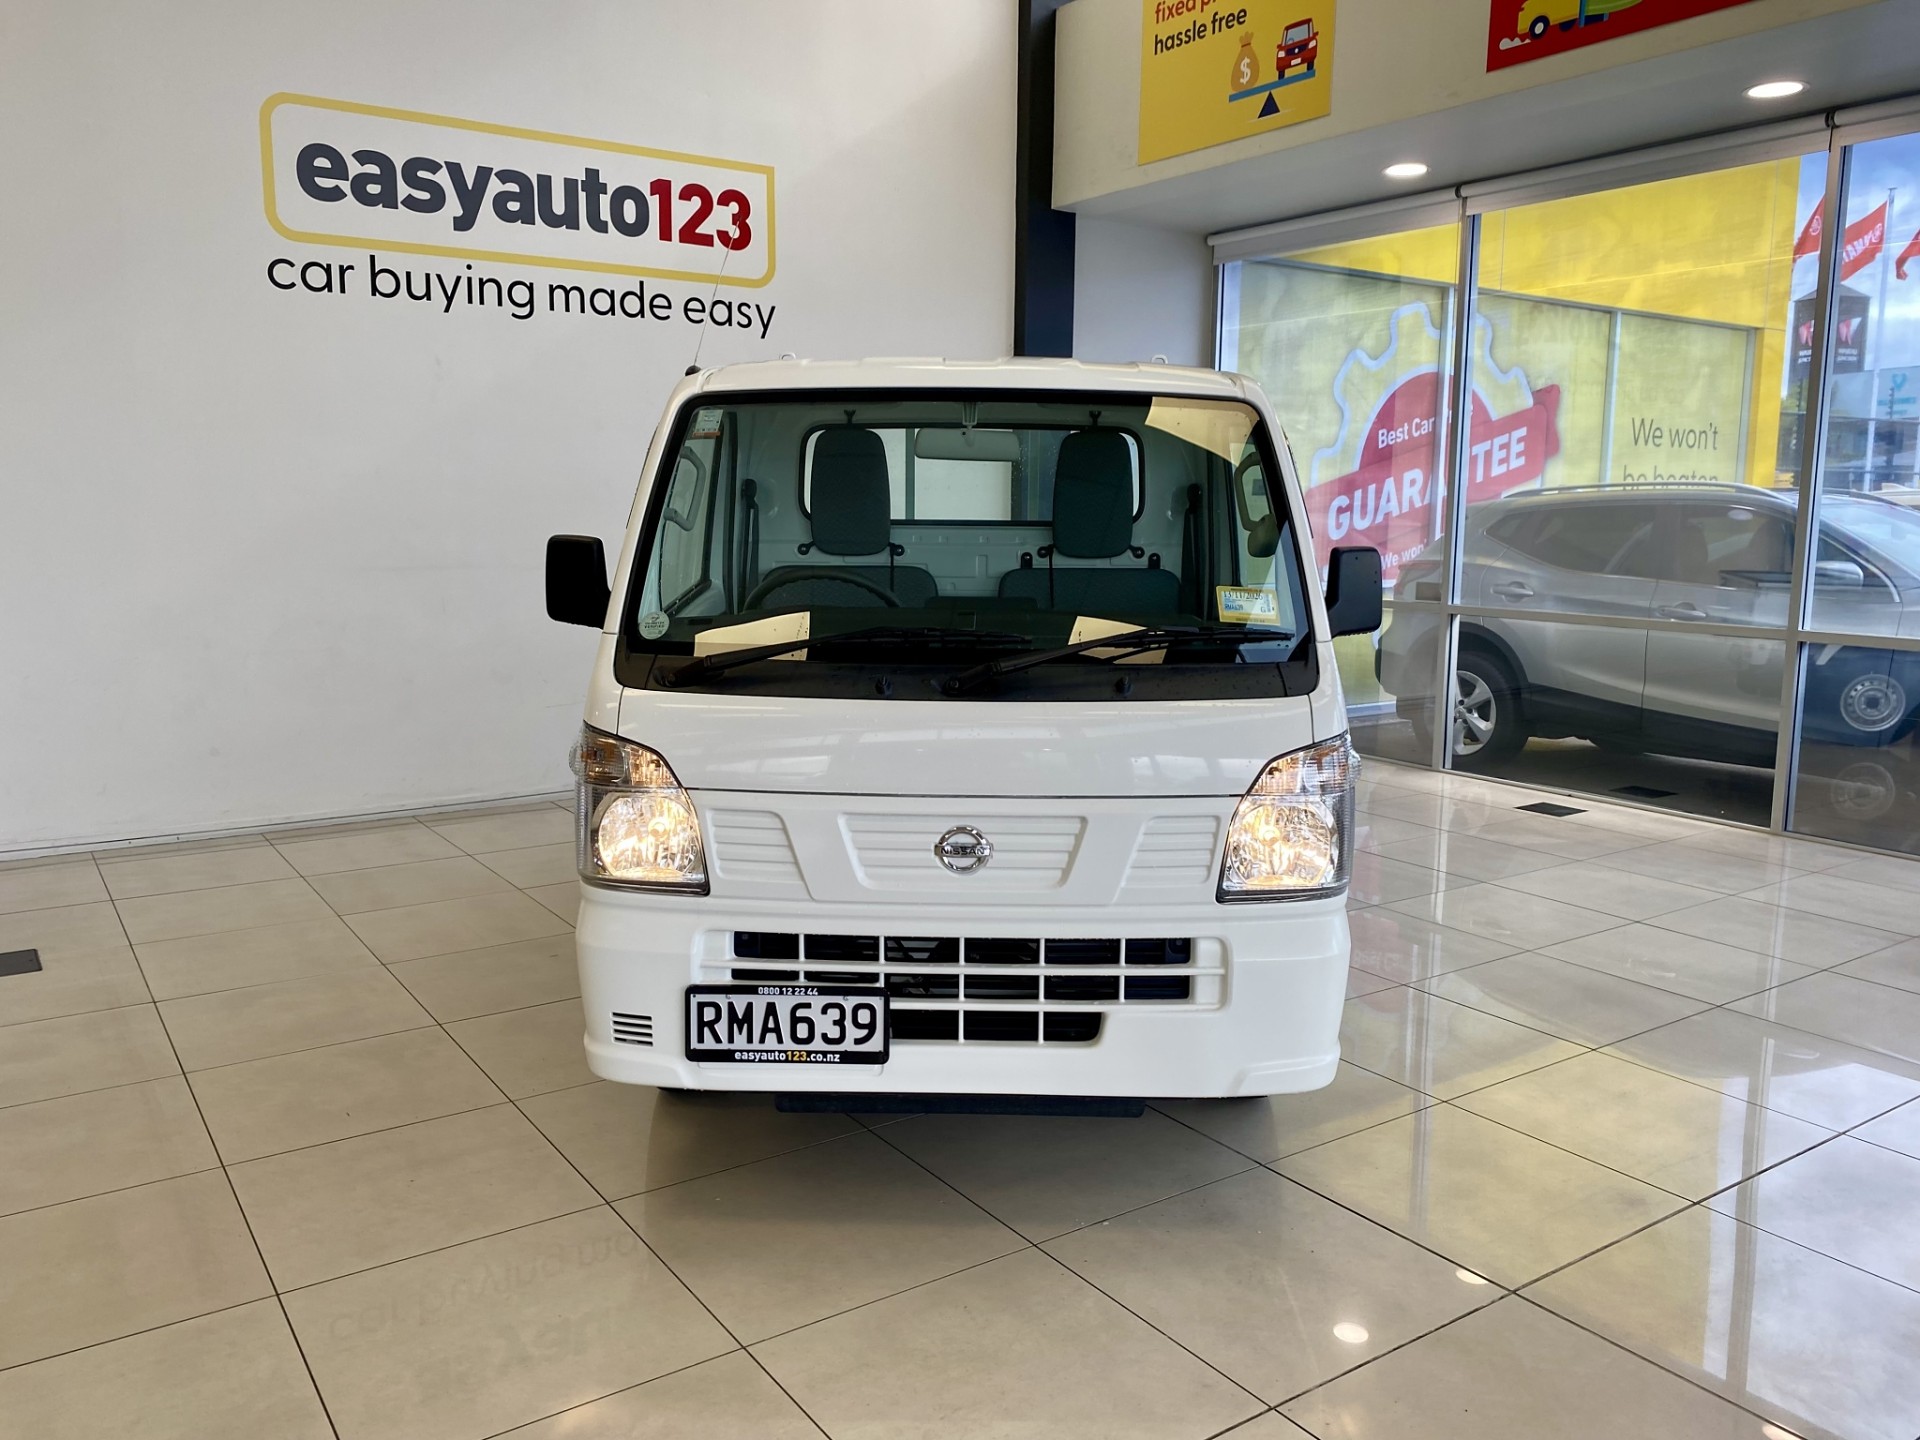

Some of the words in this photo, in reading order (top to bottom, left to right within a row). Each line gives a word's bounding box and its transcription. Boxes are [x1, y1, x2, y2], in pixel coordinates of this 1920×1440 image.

[1154, 20, 1208, 56] hassle
[1211, 8, 1248, 35] free
[295, 142, 752, 251] easyauto123
[267, 256, 356, 295] car
[369, 255, 536, 320] buying
[548, 281, 673, 322] made
[683, 295, 777, 340] easy
[1378, 421, 1409, 449] Best
[1411, 417, 1436, 438] Car
[1631, 417, 1664, 448] We
[1669, 422, 1719, 451] won't
[1326, 426, 1528, 541] GUARTEE
[1381, 551, 1399, 571] We
[940, 845, 985, 856] NISSAN
[757, 986, 780, 995] 0800
[782, 987, 793, 995] 12
[794, 987, 806, 996] 22
[807, 987, 819, 996] 44
[696, 1001, 878, 1046] RMA639
[734, 1051, 841, 1063] easyauto123.co.nz
